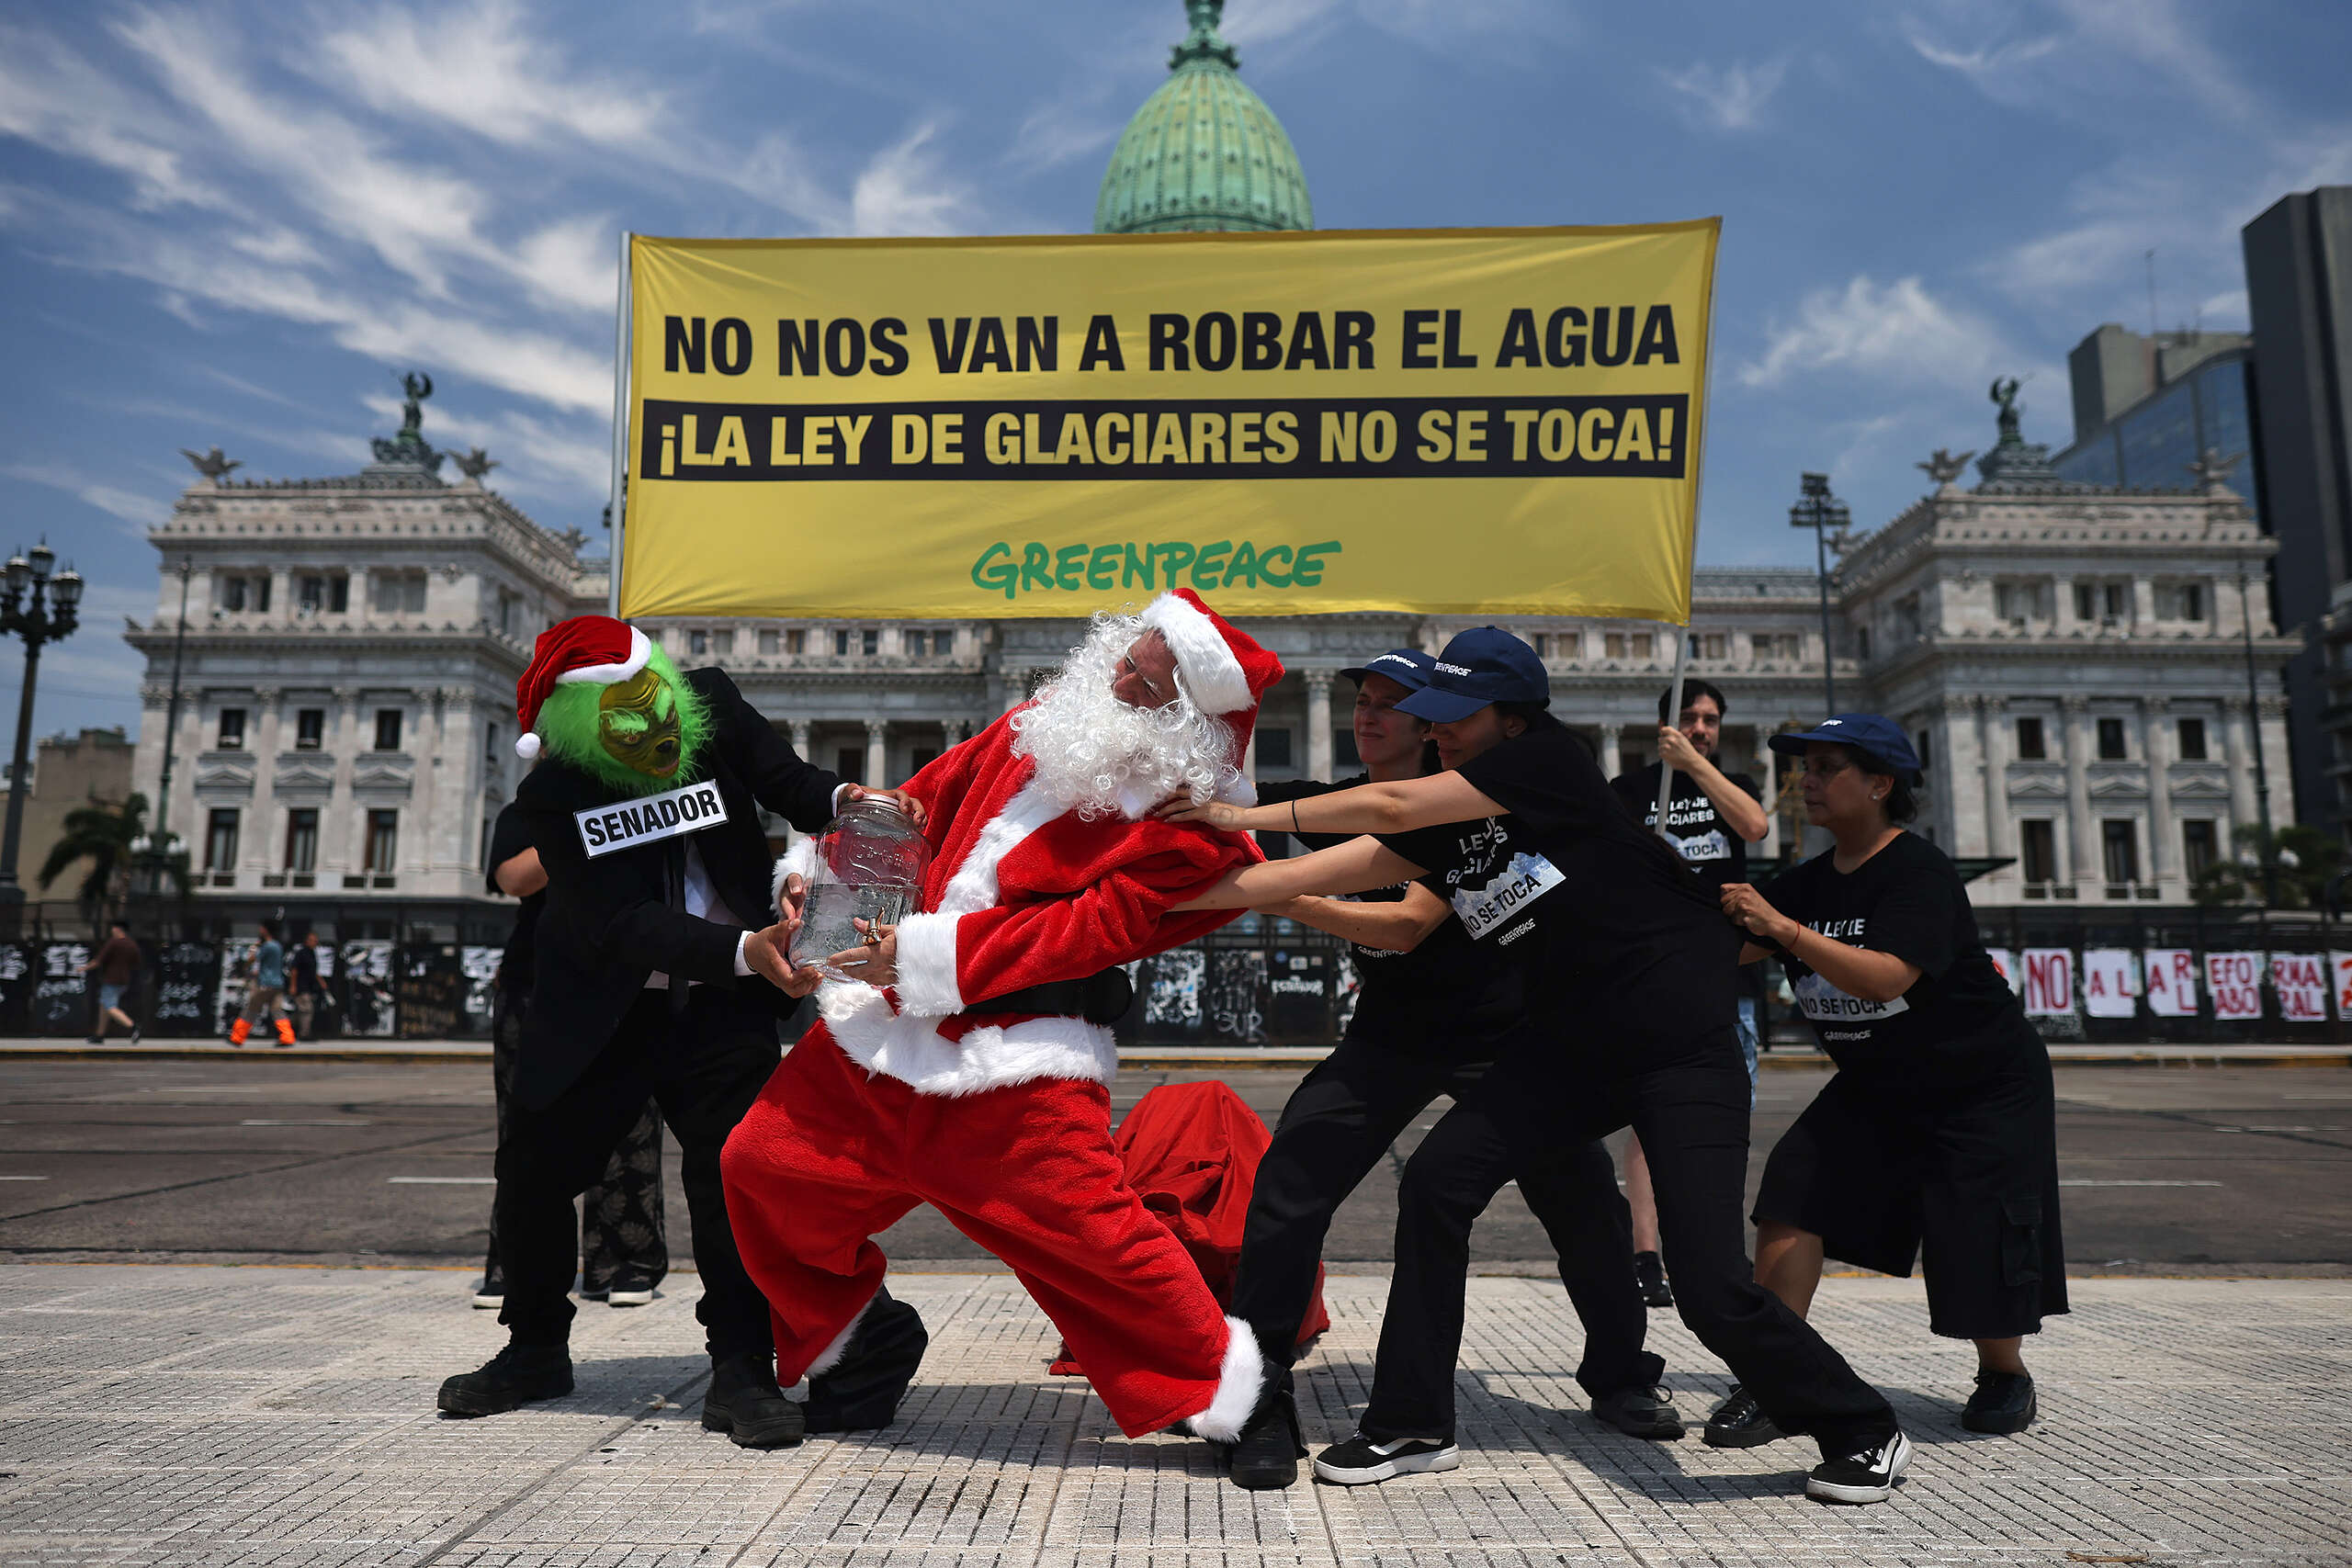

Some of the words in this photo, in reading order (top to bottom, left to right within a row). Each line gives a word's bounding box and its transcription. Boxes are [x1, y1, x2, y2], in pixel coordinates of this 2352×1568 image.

[664, 315, 752, 376] NO
[777, 317, 910, 377] NOS
[927, 316, 1058, 374] VAN
[1079, 314, 1125, 371] A
[1149, 310, 1376, 371] ROBAR
[1401, 310, 1477, 369] EL
[1495, 304, 1680, 367] AGUA
[660, 413, 752, 476] ¡LA
[770, 414, 873, 467] LEY
[890, 414, 964, 465] DE
[984, 411, 1299, 465] GLACIARES
[1319, 411, 1398, 463] NO
[1417, 410, 1488, 462] SE
[1505, 407, 1675, 462] TOCA!
[971, 540, 1342, 599] GREENPEACE
[583, 789, 721, 847] SENADOR
[1645, 808, 1715, 826] GLCIARES
[1669, 797, 1691, 812] LEY
[1684, 843, 1720, 856] TOCA
[1477, 900, 1499, 924] SE
[1492, 874, 1543, 912] TOCA
[1498, 918, 1536, 946] GREENPEACE
[1801, 998, 1818, 1013] NO
[1820, 998, 1839, 1015] SE
[1840, 999, 1887, 1015] TOCA
[2028, 954, 2068, 1010] NO
